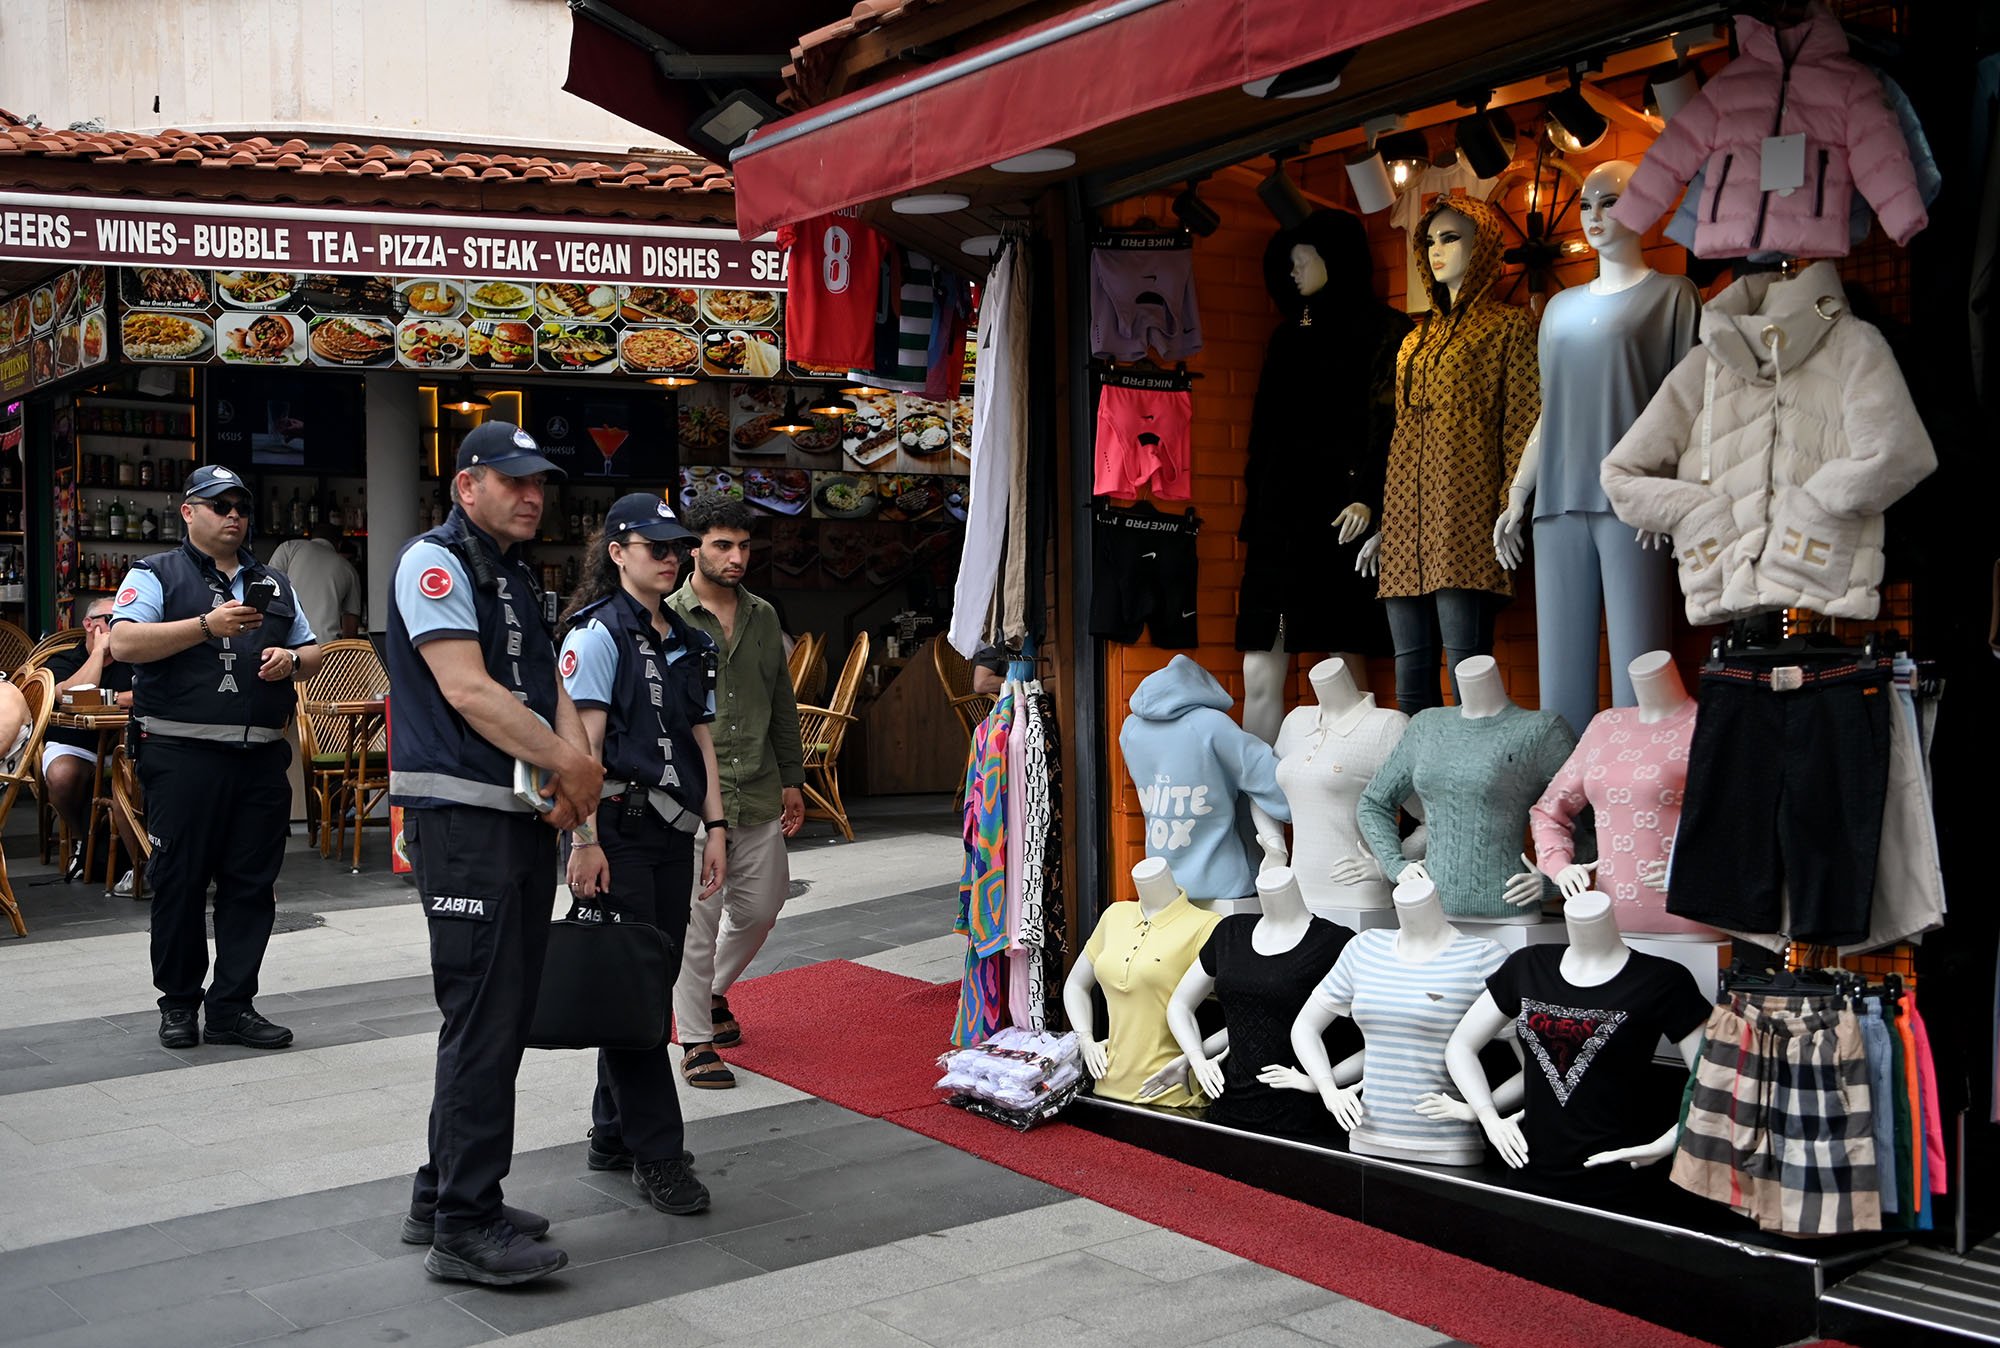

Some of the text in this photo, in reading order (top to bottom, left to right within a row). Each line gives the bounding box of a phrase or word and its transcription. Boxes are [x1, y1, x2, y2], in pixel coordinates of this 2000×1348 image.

[0, 211, 86, 248] EERS-
[643, 246, 720, 279] DISHES
[1121, 238, 1146, 248] PRO
[1147, 237, 1175, 248] NIKE
[824, 226, 851, 293] 8
[1121, 376, 1173, 389] NIKE PRO
[1125, 518, 1180, 533] NIKE PRO
[636, 633, 681, 787] ZABITA
[432, 896, 485, 916] ZABITA
